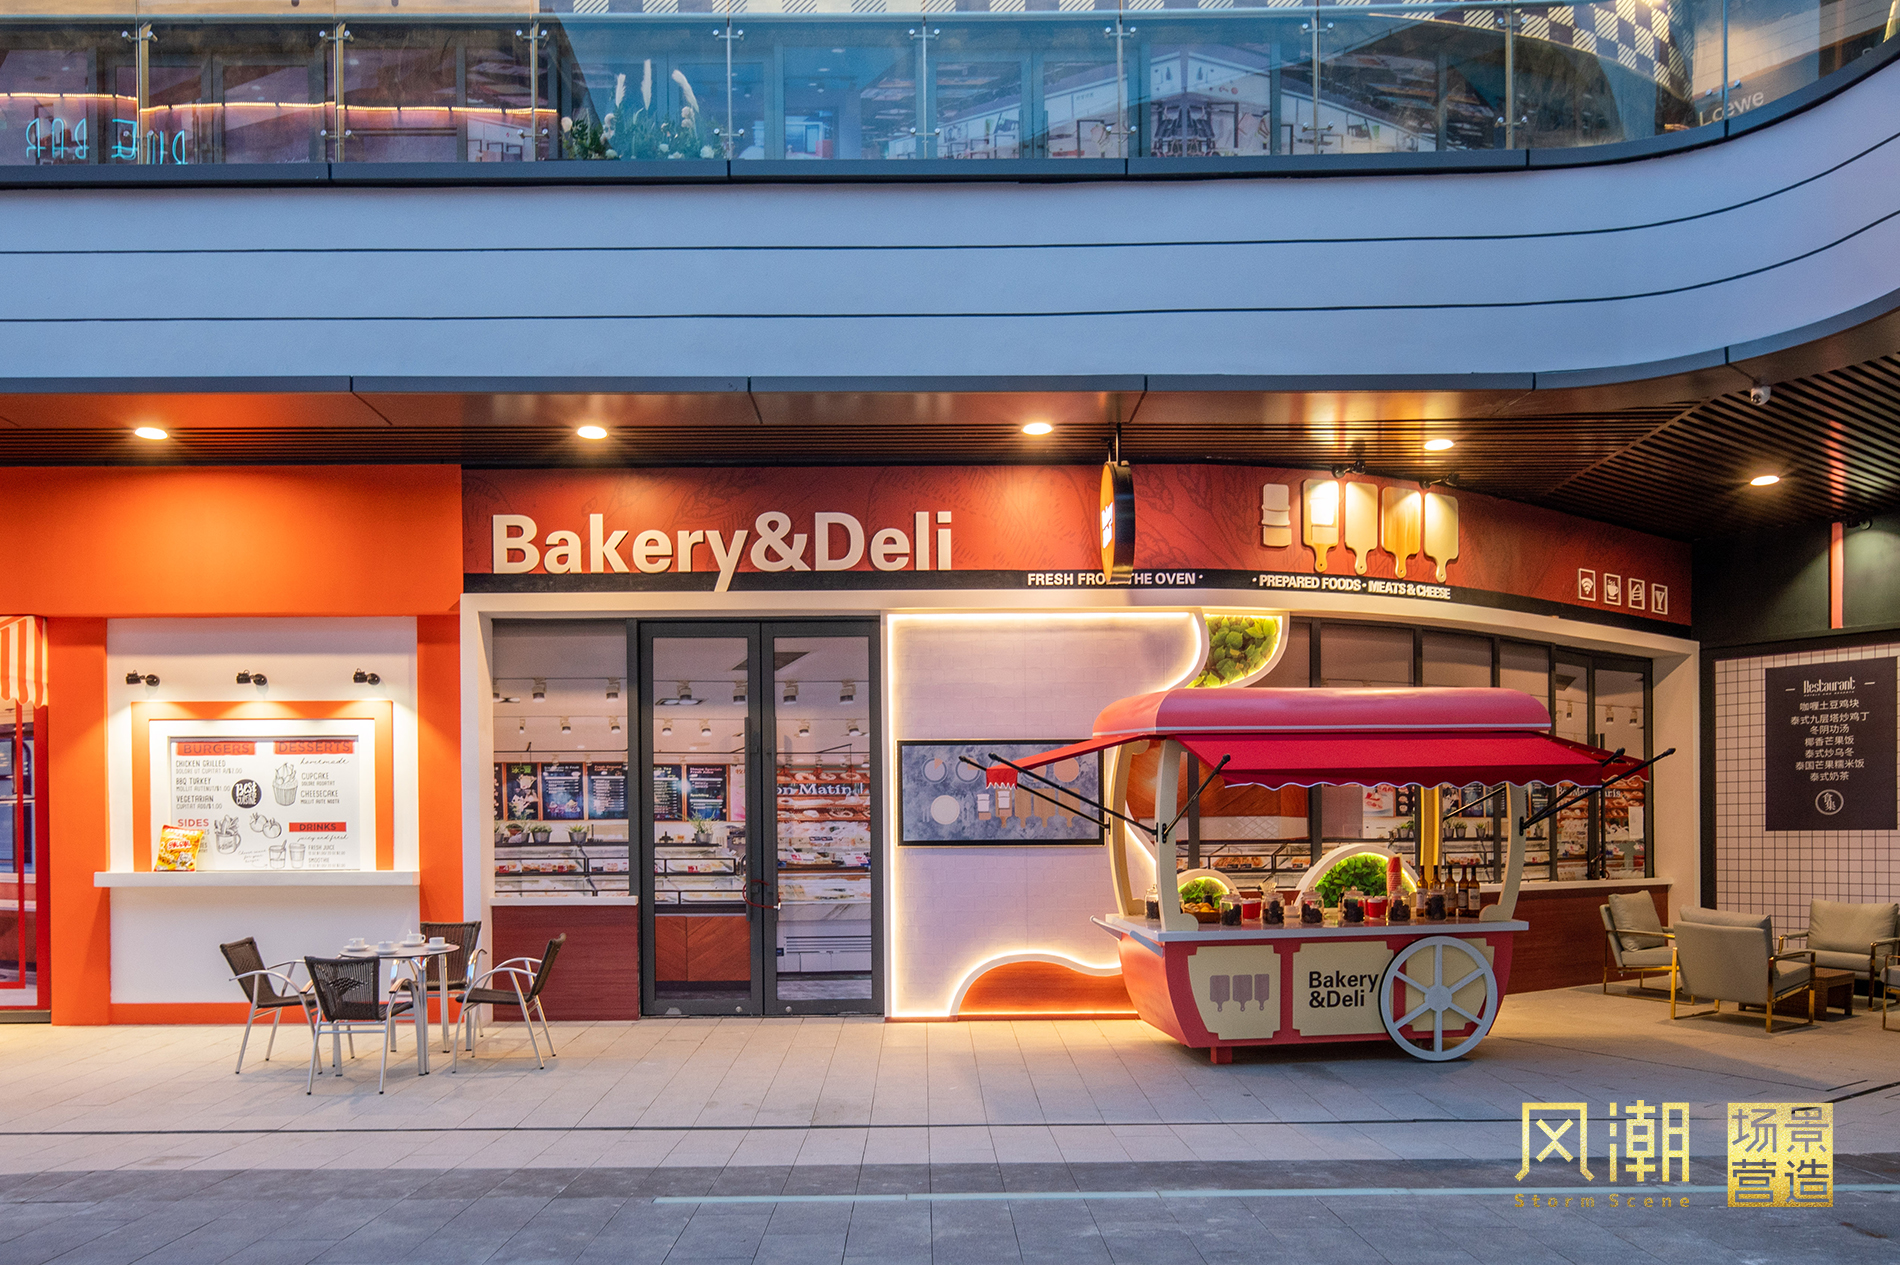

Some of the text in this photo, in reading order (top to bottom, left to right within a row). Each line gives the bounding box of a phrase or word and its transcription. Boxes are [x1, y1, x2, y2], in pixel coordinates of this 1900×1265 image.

[492, 511, 952, 592] Bakery&Deli
[1027, 573, 1074, 586] FRESH
[1077, 573, 1107, 586] FRO
[1154, 572, 1196, 586] OVEN
[1259, 574, 1320, 589] PREPARED
[1321, 578, 1362, 591] FOODS
[1368, 580, 1406, 595] MEATS
[1417, 584, 1451, 600] CHEESE
[1803, 676, 1856, 694] Restaurant
[1810, 724, 1850, 735] 冬阴功汤
[183, 744, 250, 754] BURGERS
[278, 740, 350, 752] DESSERTS
[301, 772, 329, 780] CUPCAKE
[1809, 771, 1850, 782] 泰式奶茶
[178, 818, 209, 827] SIDES
[299, 823, 337, 831] DRINKS
[1308, 971, 1379, 993] Bakery
[1308, 990, 1365, 1008] &Deli
